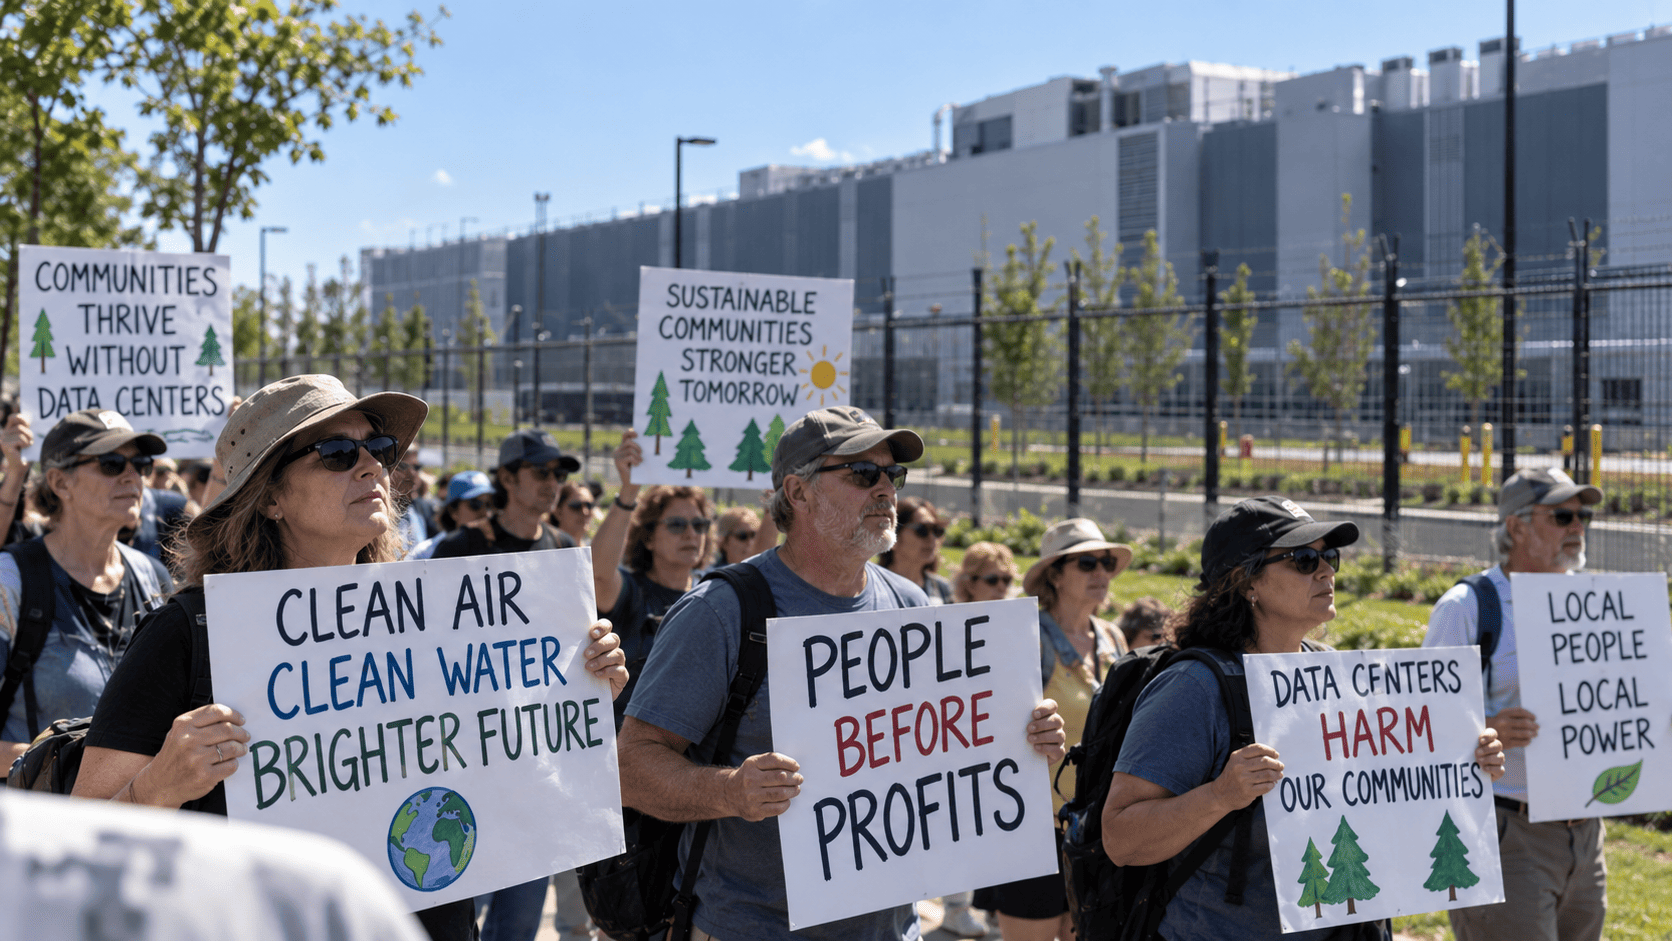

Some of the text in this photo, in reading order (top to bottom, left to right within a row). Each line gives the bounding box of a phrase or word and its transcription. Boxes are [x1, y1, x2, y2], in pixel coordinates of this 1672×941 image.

[35, 260, 218, 297] COMMUNITIES
[666, 283, 818, 315] SUSTAINABLE
[77, 303, 177, 336] THRIVE
[658, 314, 813, 346] COMMUNITIES
[65, 345, 186, 376] WITHOUT
[680, 347, 798, 377] STRONGER
[37, 385, 225, 419] DATA CENTERS
[678, 379, 800, 407] TOMORROW
[275, 566, 531, 647] CLEAN AIR
[1547, 590, 1635, 625] LOCAL
[802, 614, 992, 709] PEOPLE
[1550, 629, 1648, 666] PEOPLE
[267, 635, 568, 721] CLEAN WATER
[1270, 664, 1342, 709] DATA
[1558, 676, 1650, 716] LOCAL
[833, 689, 995, 778] BEFORE
[1319, 704, 1435, 762] HARM
[1560, 717, 1656, 760] POWER
[248, 697, 604, 811] BRIGHTER FUTURE
[1279, 761, 1484, 813] OUR COMMUNITIES
[812, 757, 1026, 882] PROFITS
